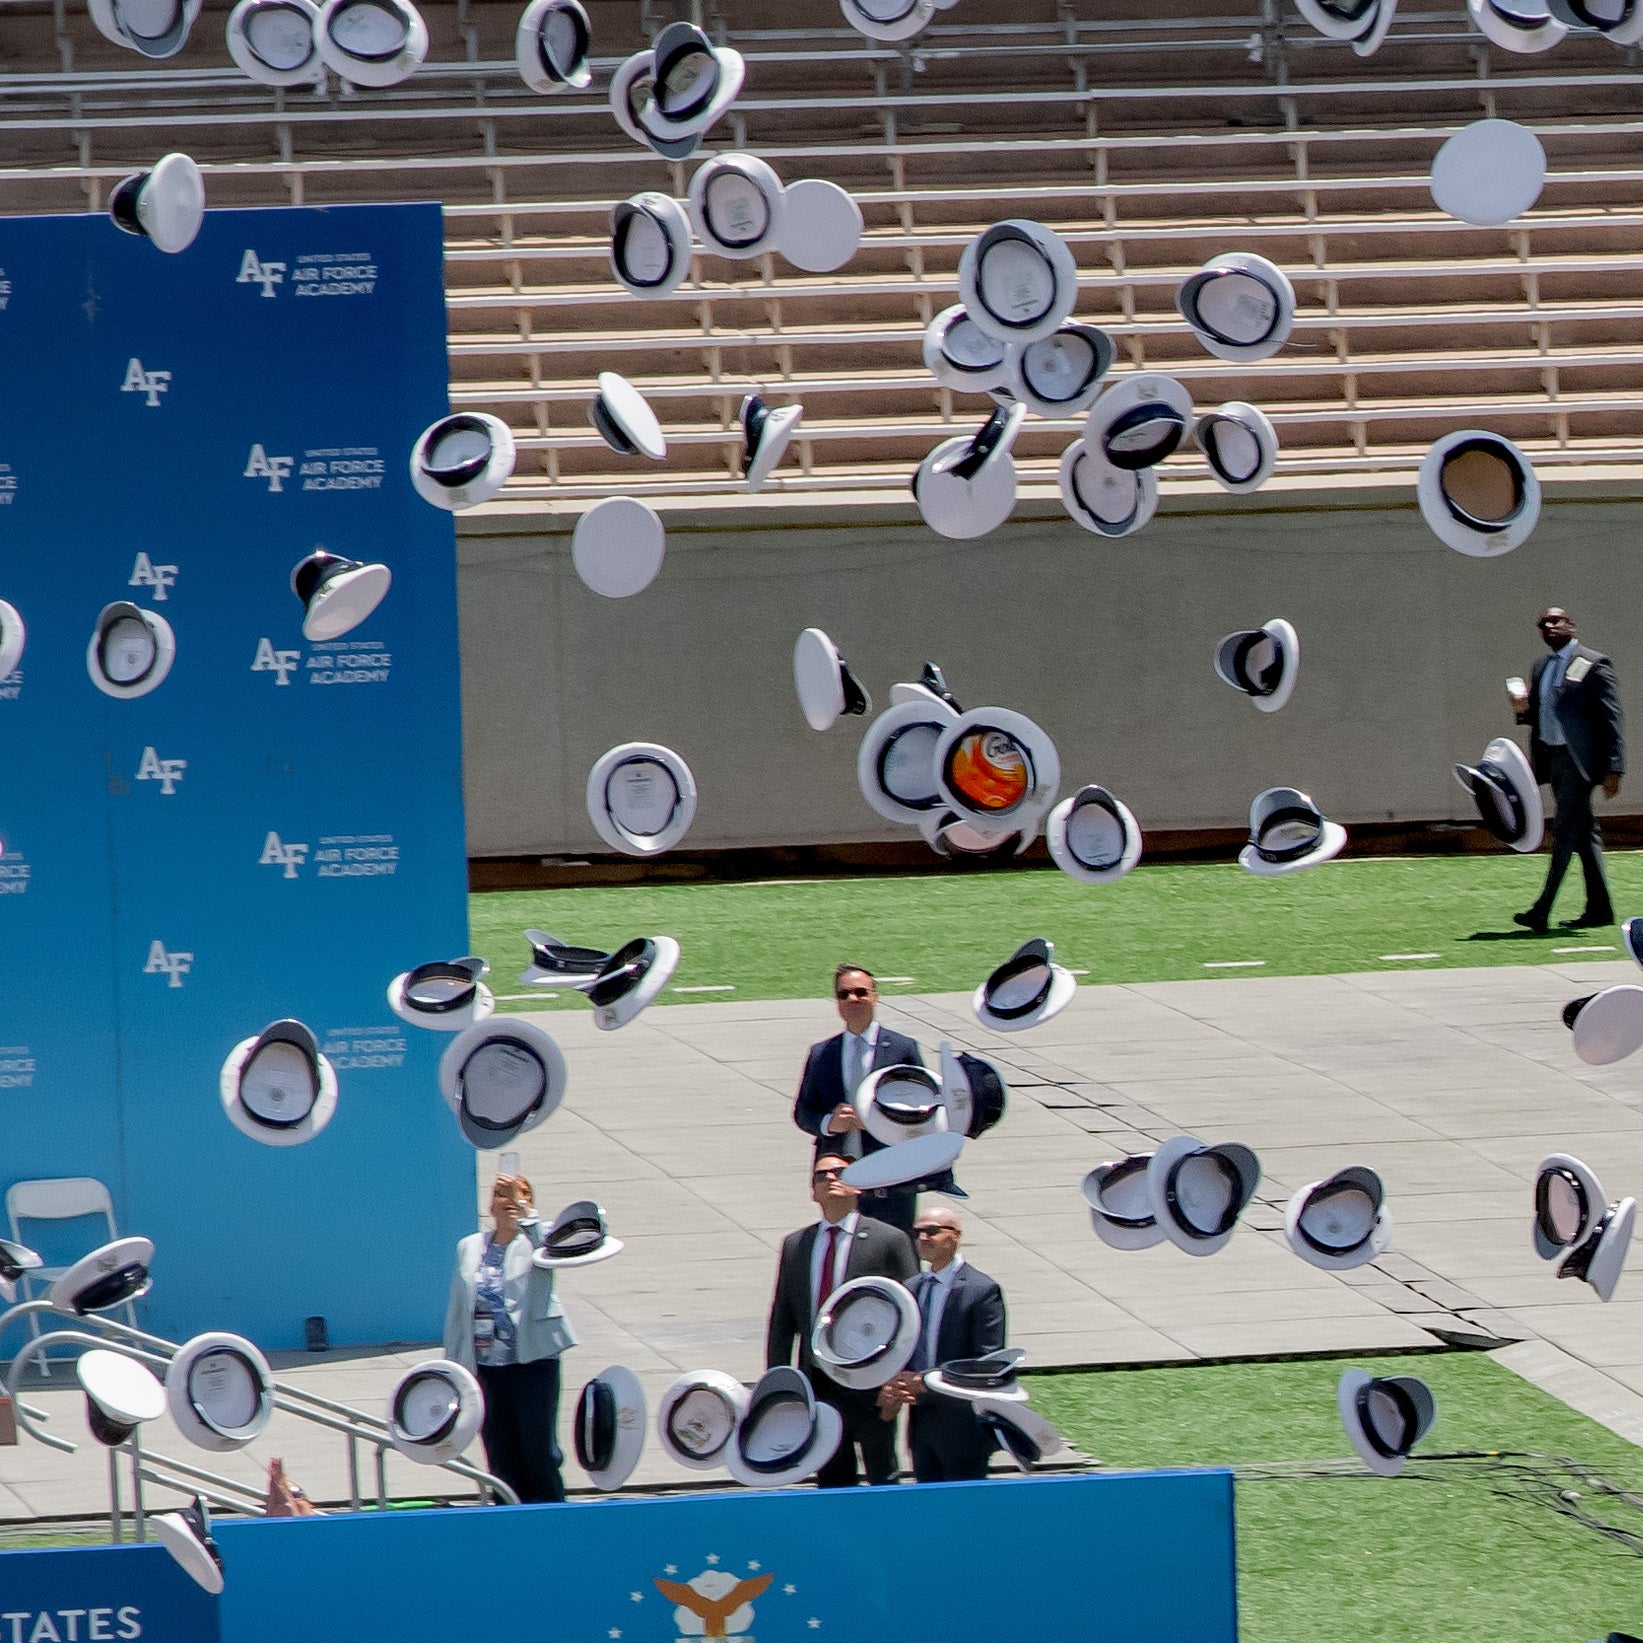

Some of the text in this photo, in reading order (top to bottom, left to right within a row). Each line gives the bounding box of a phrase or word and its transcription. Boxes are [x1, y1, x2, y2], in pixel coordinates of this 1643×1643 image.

[236, 249, 287, 298] AF
[292, 265, 378, 281] AIR FORCE
[295, 281, 375, 296] ACADEMY
[120, 357, 172, 406] AF
[243, 443, 295, 492] AF
[330, 459, 385, 473] FORCE
[128, 551, 179, 601] AF
[250, 637, 301, 686] AF
[336, 653, 392, 667] FORCE
[135, 746, 188, 795] AF
[258, 831, 309, 879] AF
[142, 940, 194, 988] AF
